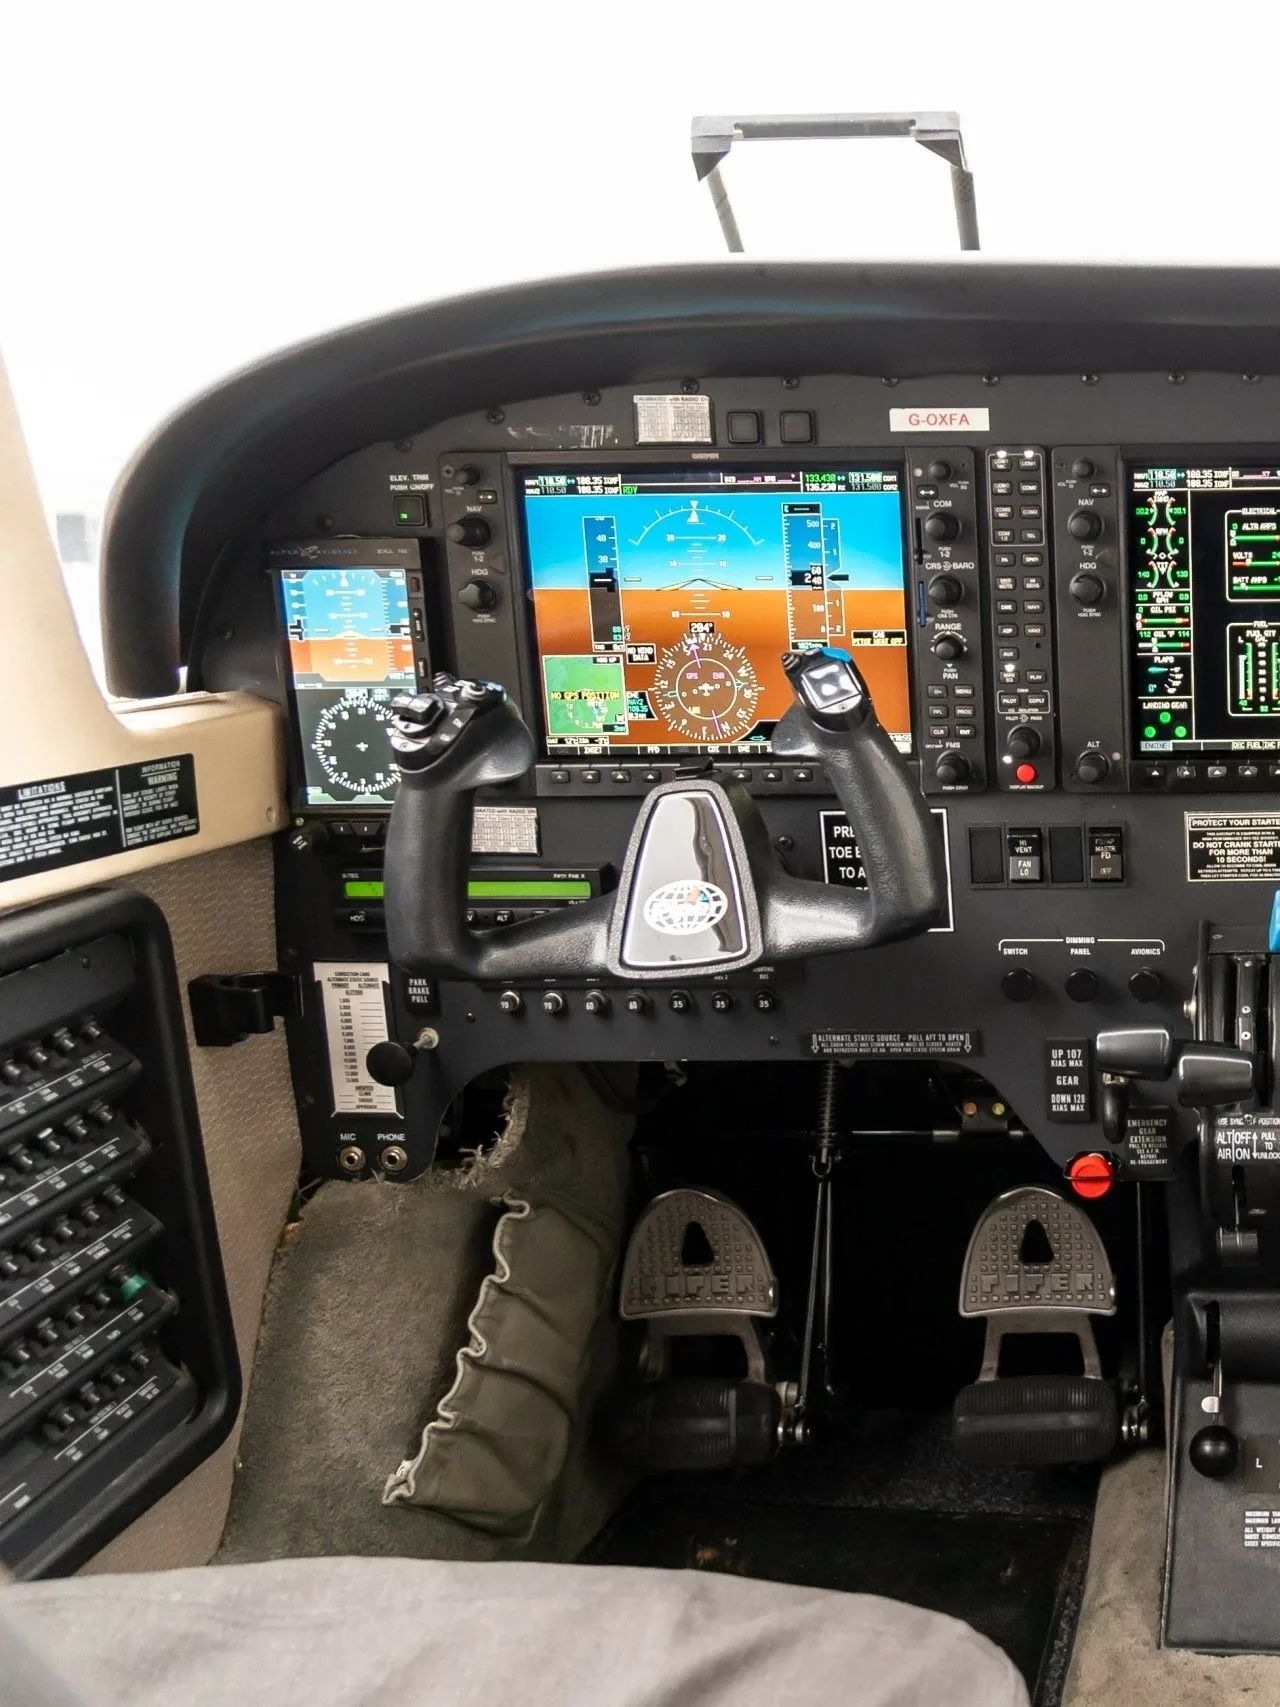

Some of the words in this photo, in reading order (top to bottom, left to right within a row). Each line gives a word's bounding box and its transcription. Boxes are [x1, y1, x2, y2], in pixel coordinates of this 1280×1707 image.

[908, 413, 970, 426] G-OXFA
[926, 562, 941, 570] CRS
[952, 562, 974, 570] BARO
[142, 761, 180, 773] INFORMATION
[148, 773, 177, 785] WARNING
[18, 781, 66, 798] LIMITATIONS
[829, 847, 852, 858] TOE
[839, 867, 855, 878] TO
[408, 987, 429, 995] BRAKE
[673, 1000, 683, 1008] 35
[716, 1000, 726, 1008] 35
[759, 1000, 769, 1008] 35
[1052, 1050, 1063, 1058] UP
[1067, 1050, 1081, 1058] 107
[1056, 1076, 1079, 1085] GEAR
[1052, 1094, 1070, 1103] DOWN
[1074, 1094, 1085, 1103] 128
[1217, 1132, 1232, 1144] ALT
[1235, 1132, 1252, 1144] OFF
[1265, 1142, 1273, 1150] TO
[1217, 1149, 1231, 1159] AIR
[1236, 1149, 1250, 1159] ON
[981, 1272, 1095, 1292] PIPER
[1256, 1458, 1262, 1468] L
